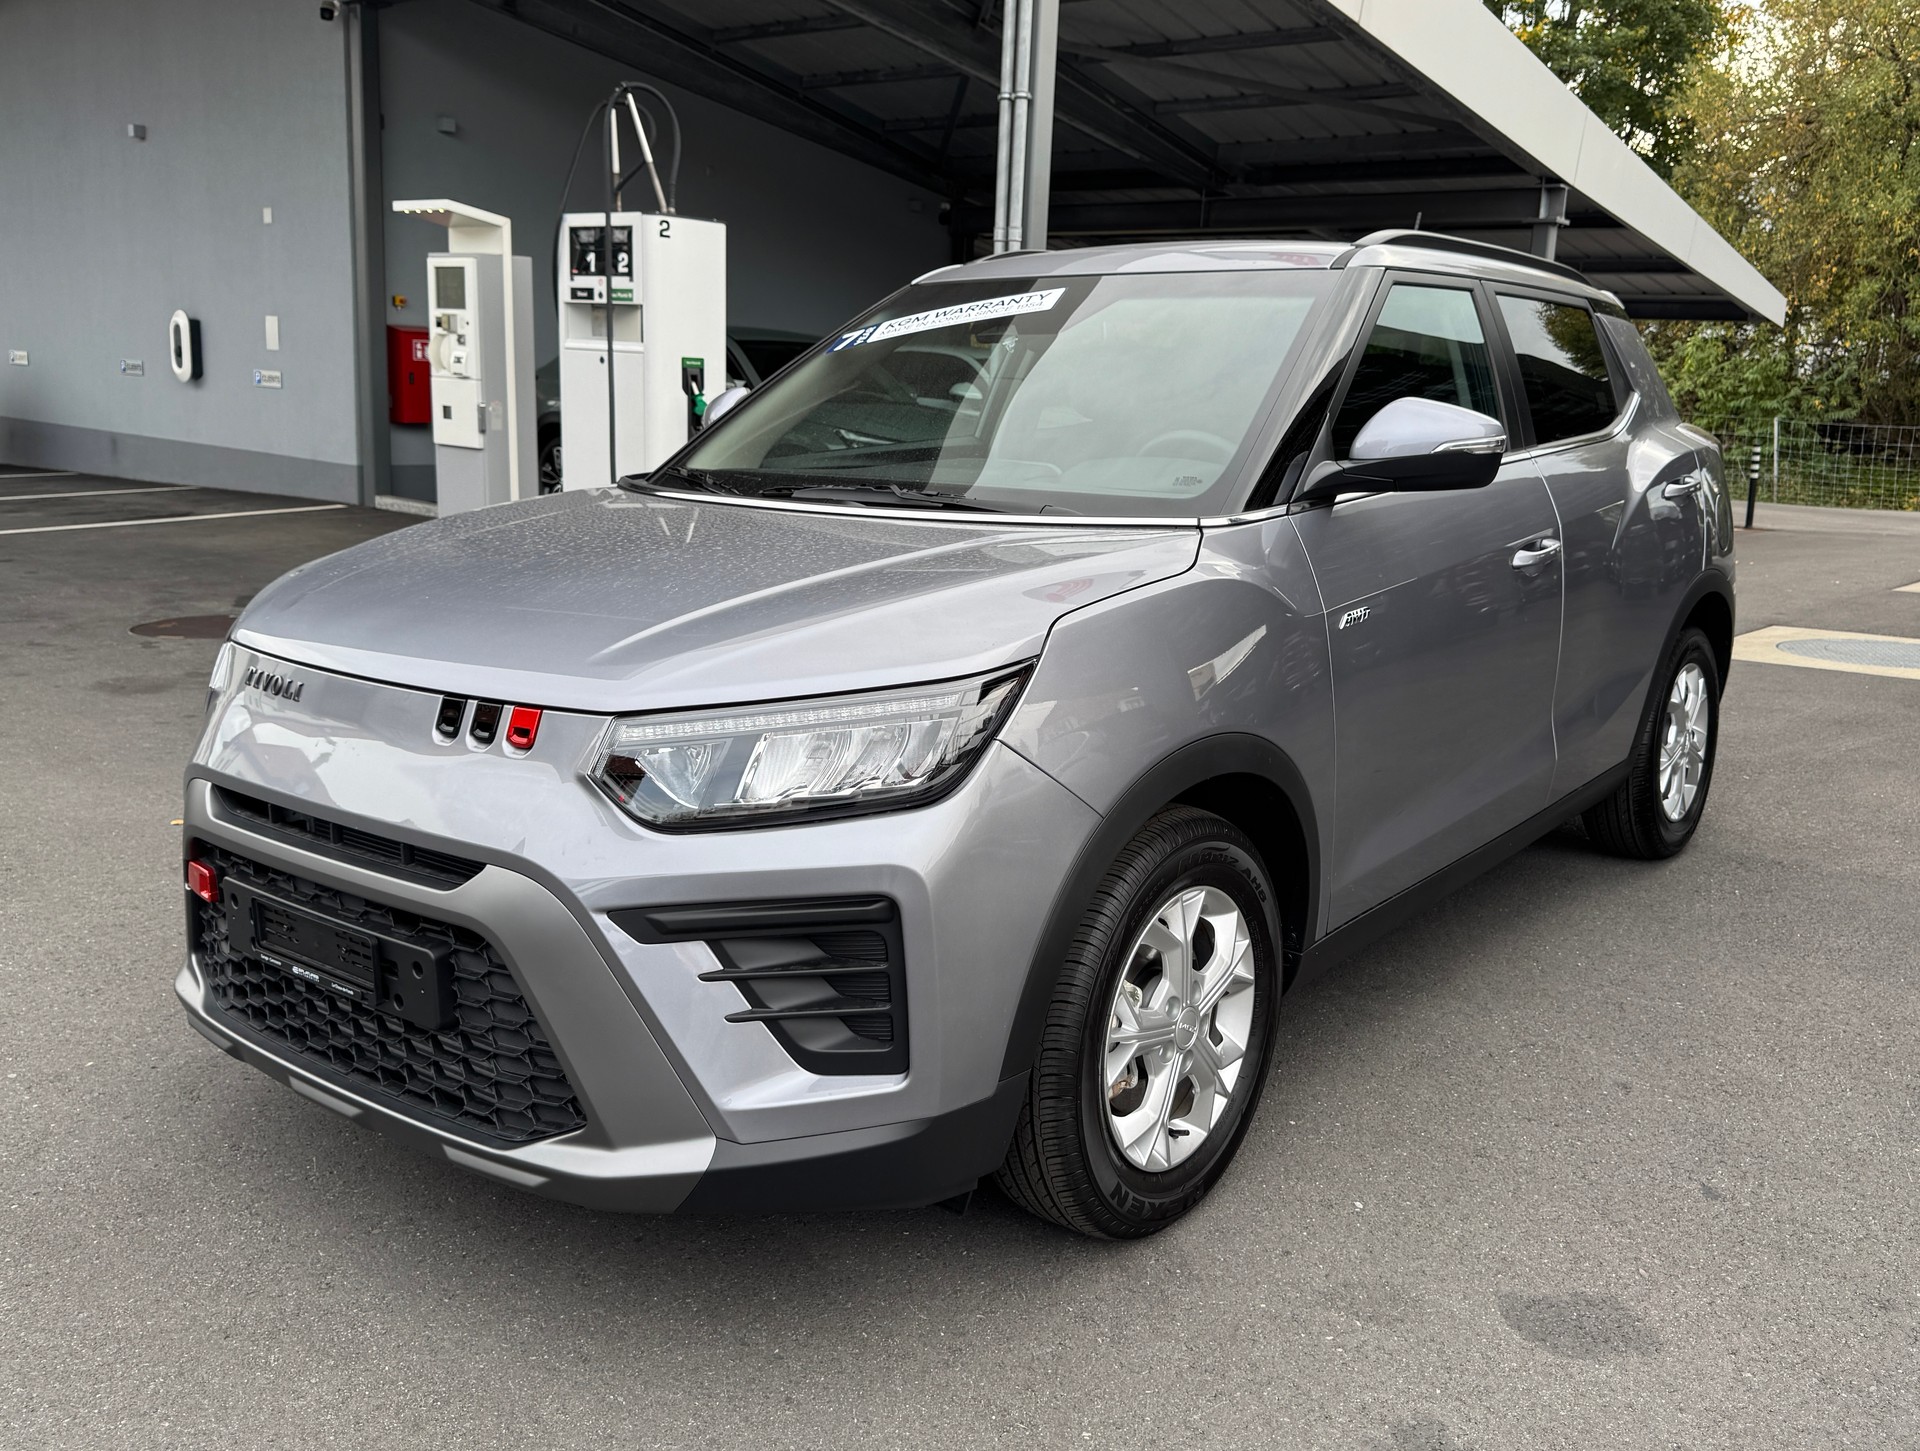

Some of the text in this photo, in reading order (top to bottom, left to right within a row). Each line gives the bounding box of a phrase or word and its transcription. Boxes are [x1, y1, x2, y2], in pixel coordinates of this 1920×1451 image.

[659, 220, 671, 238] 2
[585, 251, 596, 273] 1
[617, 251, 629, 273] 2
[885, 291, 1053, 330] KGM WARRANTY
[975, 304, 1014, 317] SINCE
[833, 328, 866, 352] 7
[244, 665, 304, 703] TIVOLI
